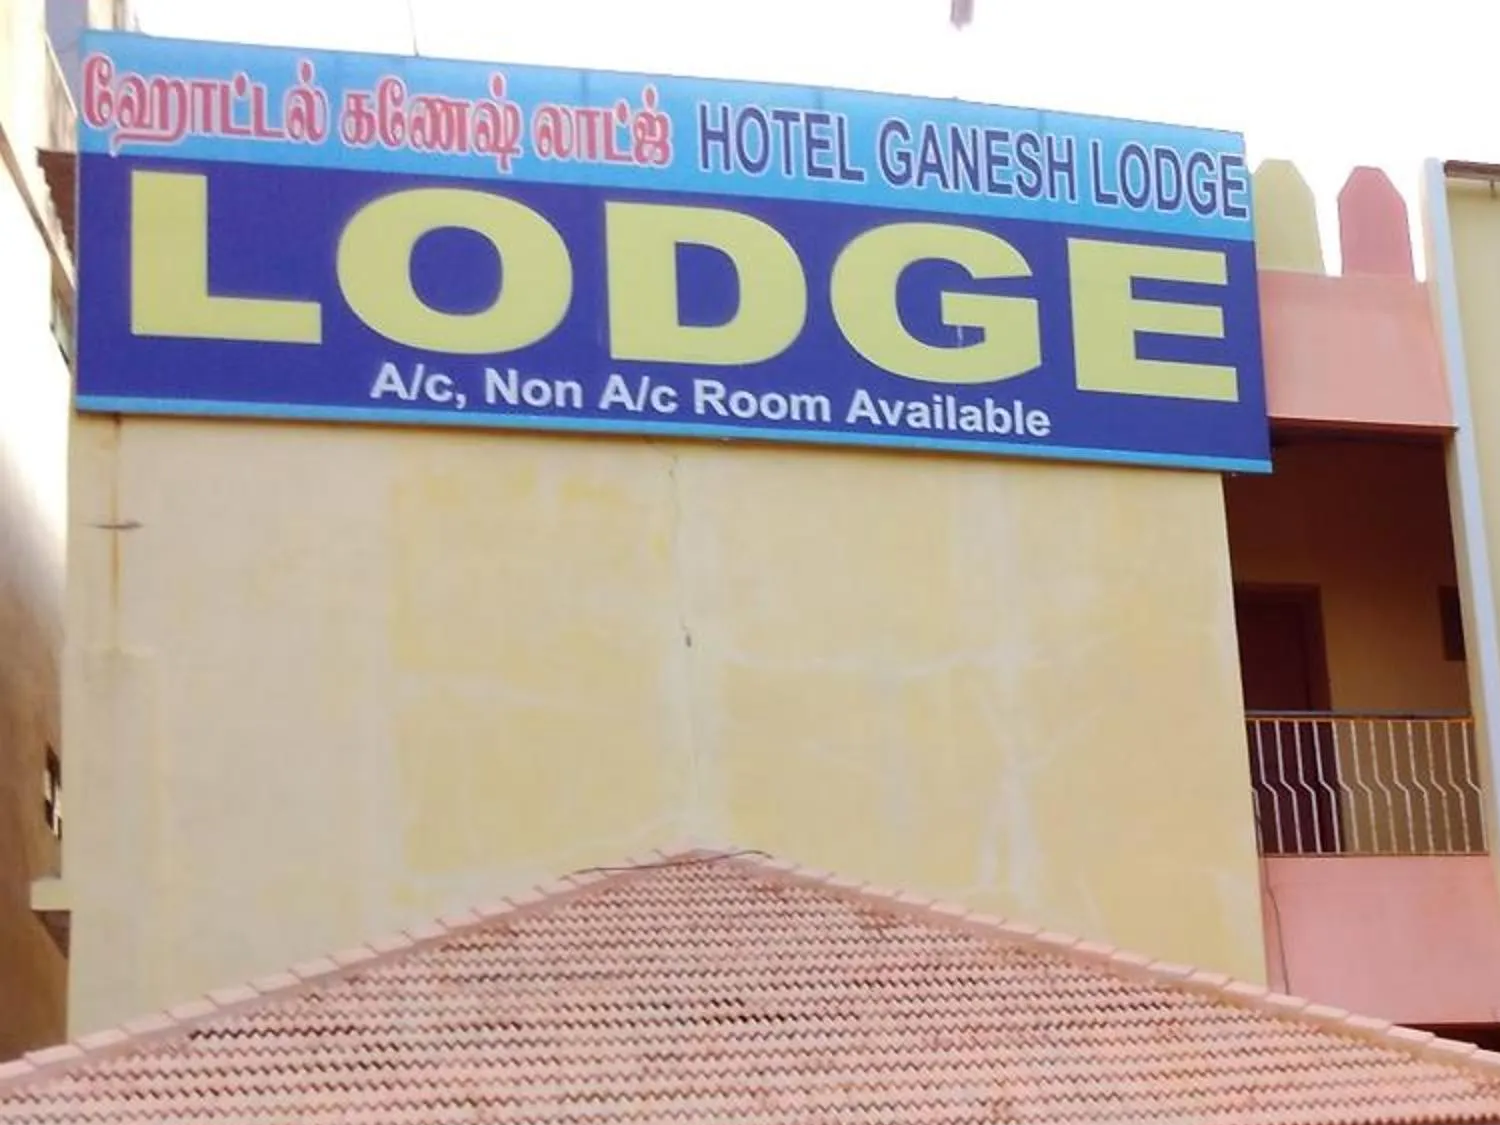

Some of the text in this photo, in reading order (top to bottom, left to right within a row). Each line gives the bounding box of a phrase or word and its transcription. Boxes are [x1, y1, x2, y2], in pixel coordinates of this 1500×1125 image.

[700, 102, 1249, 219] HOTEL GANESH LODGE
[129, 171, 1240, 402] LODGE
[370, 361, 1053, 438] A/c, Non A/c Room Available
